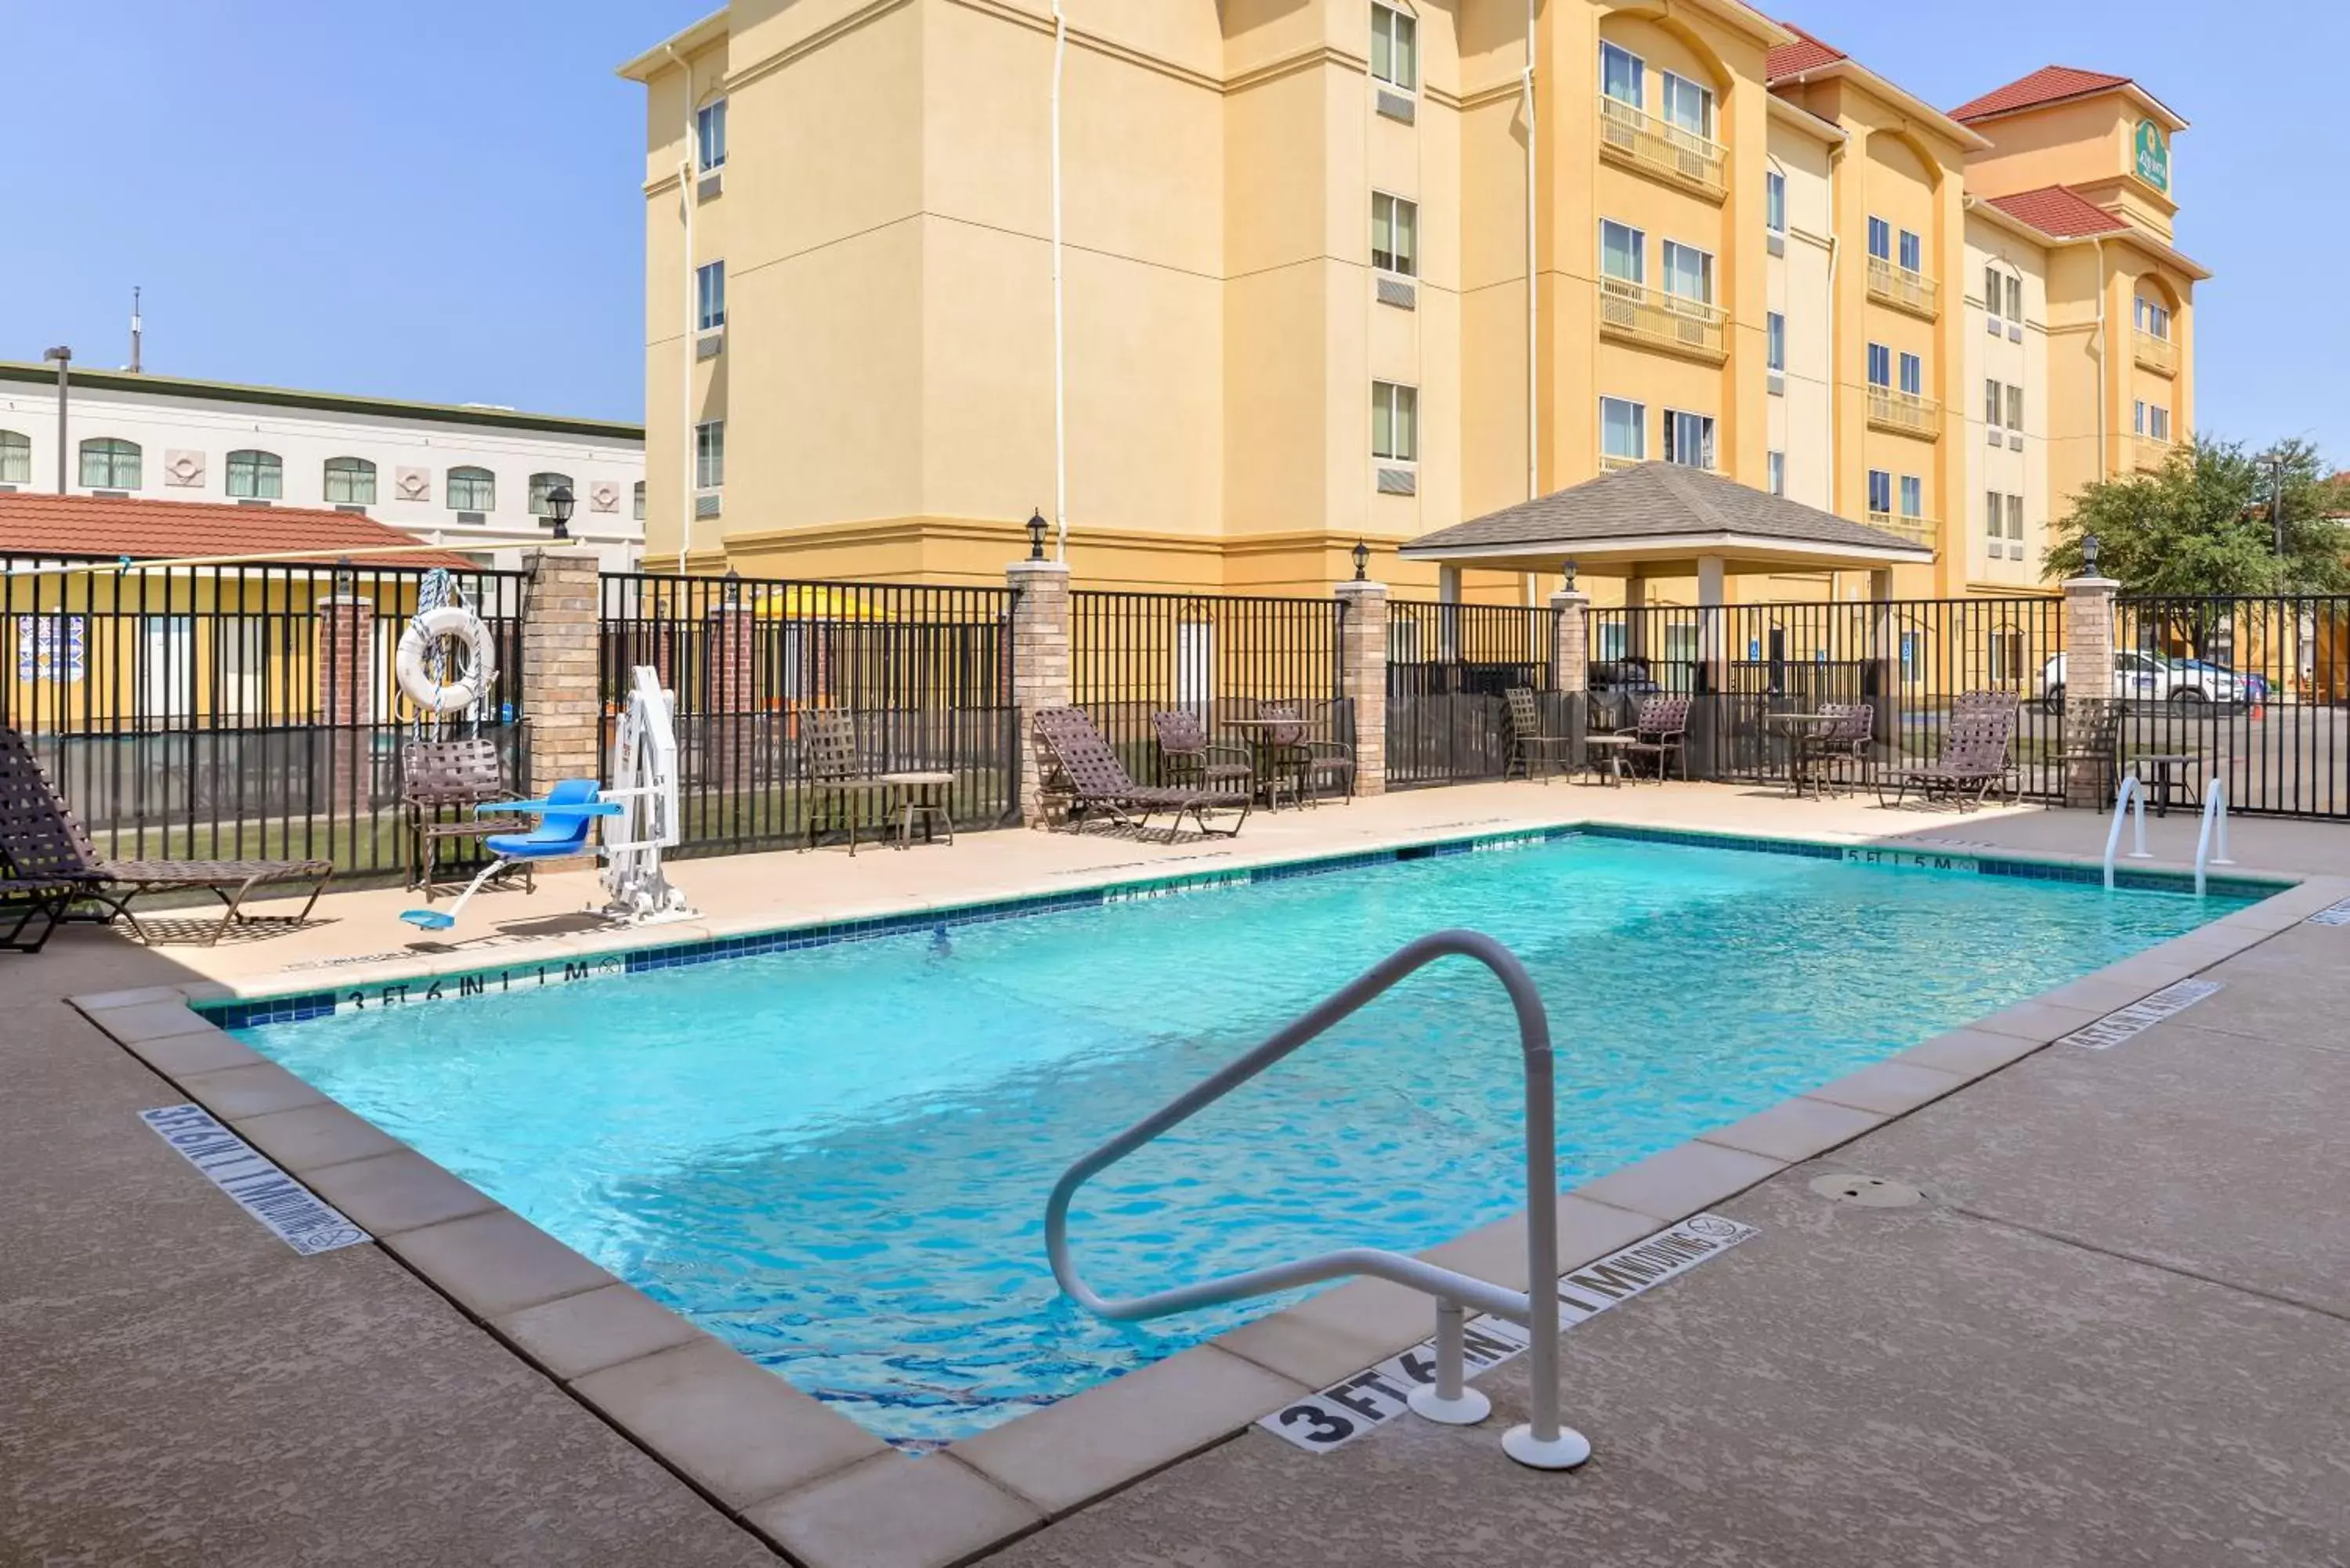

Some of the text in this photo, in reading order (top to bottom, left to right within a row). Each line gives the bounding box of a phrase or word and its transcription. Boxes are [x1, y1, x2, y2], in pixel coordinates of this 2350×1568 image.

[1849, 850, 1858, 860] 5
[1934, 858, 1951, 869] M
[349, 991, 364, 1009] 3
[382, 985, 410, 1006] FT
[426, 981, 442, 1000] 6
[460, 974, 483, 997] IN
[564, 961, 588, 981] M
[144, 1106, 200, 1120] 3
[230, 1179, 303, 1204] M
[1609, 1255, 1668, 1279] NO
[1630, 1232, 1719, 1268] DIVING
[1567, 1263, 1650, 1299] M
[1398, 1353, 1437, 1385] 6
[1325, 1371, 1408, 1422] FT
[1279, 1405, 1354, 1443] 3
